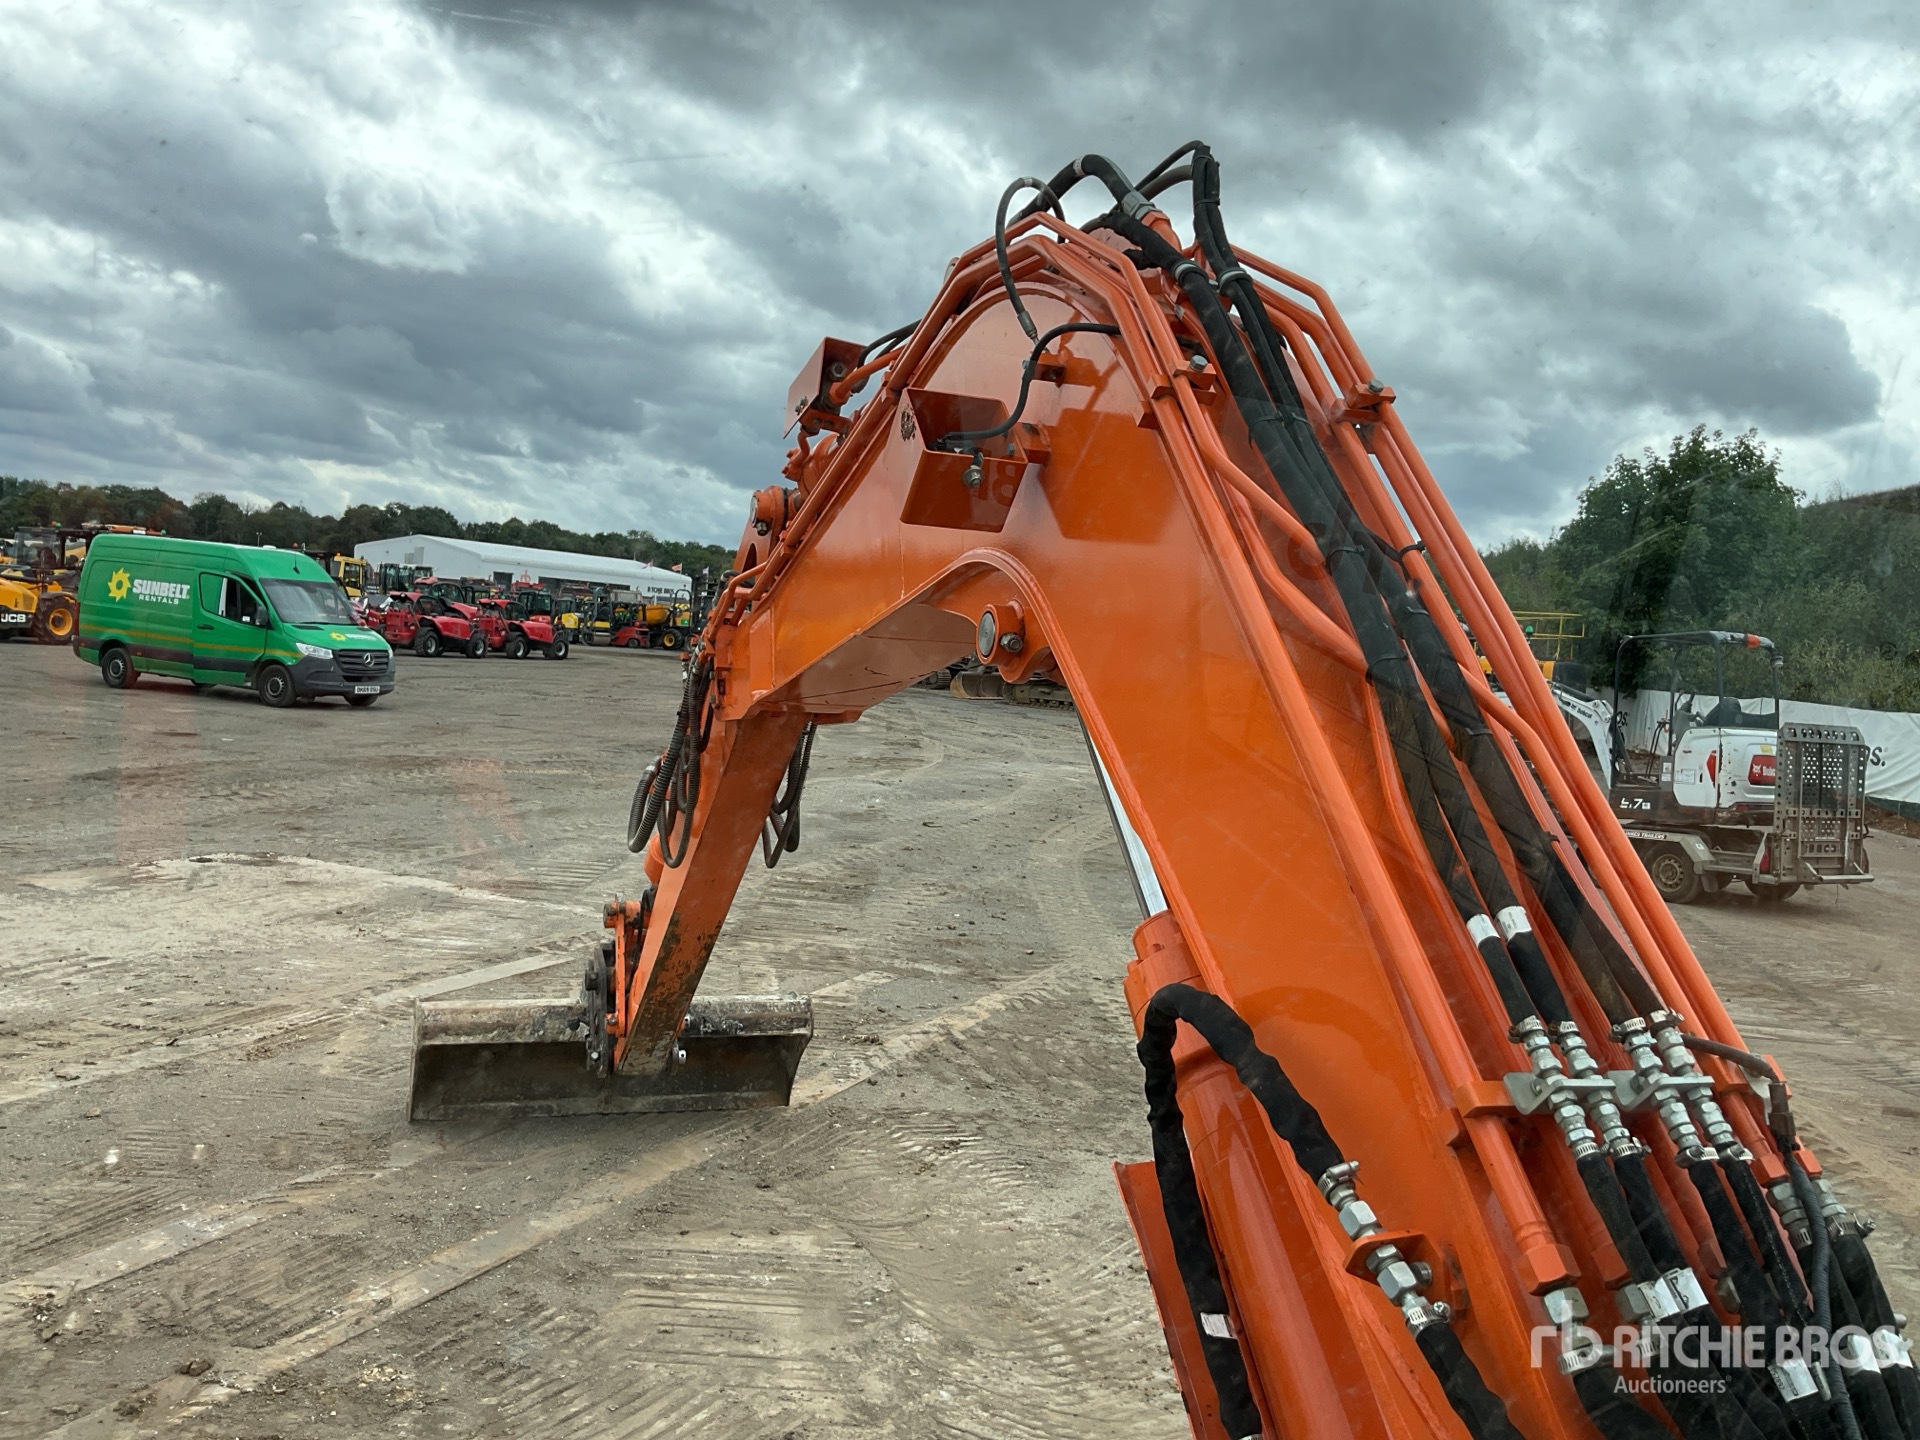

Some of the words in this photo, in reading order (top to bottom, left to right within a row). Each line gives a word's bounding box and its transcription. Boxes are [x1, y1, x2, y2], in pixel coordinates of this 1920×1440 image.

[132, 579, 190, 599] SUNBELT
[138, 594, 179, 605] RENTALS
[1, 613, 26, 622] JCB
